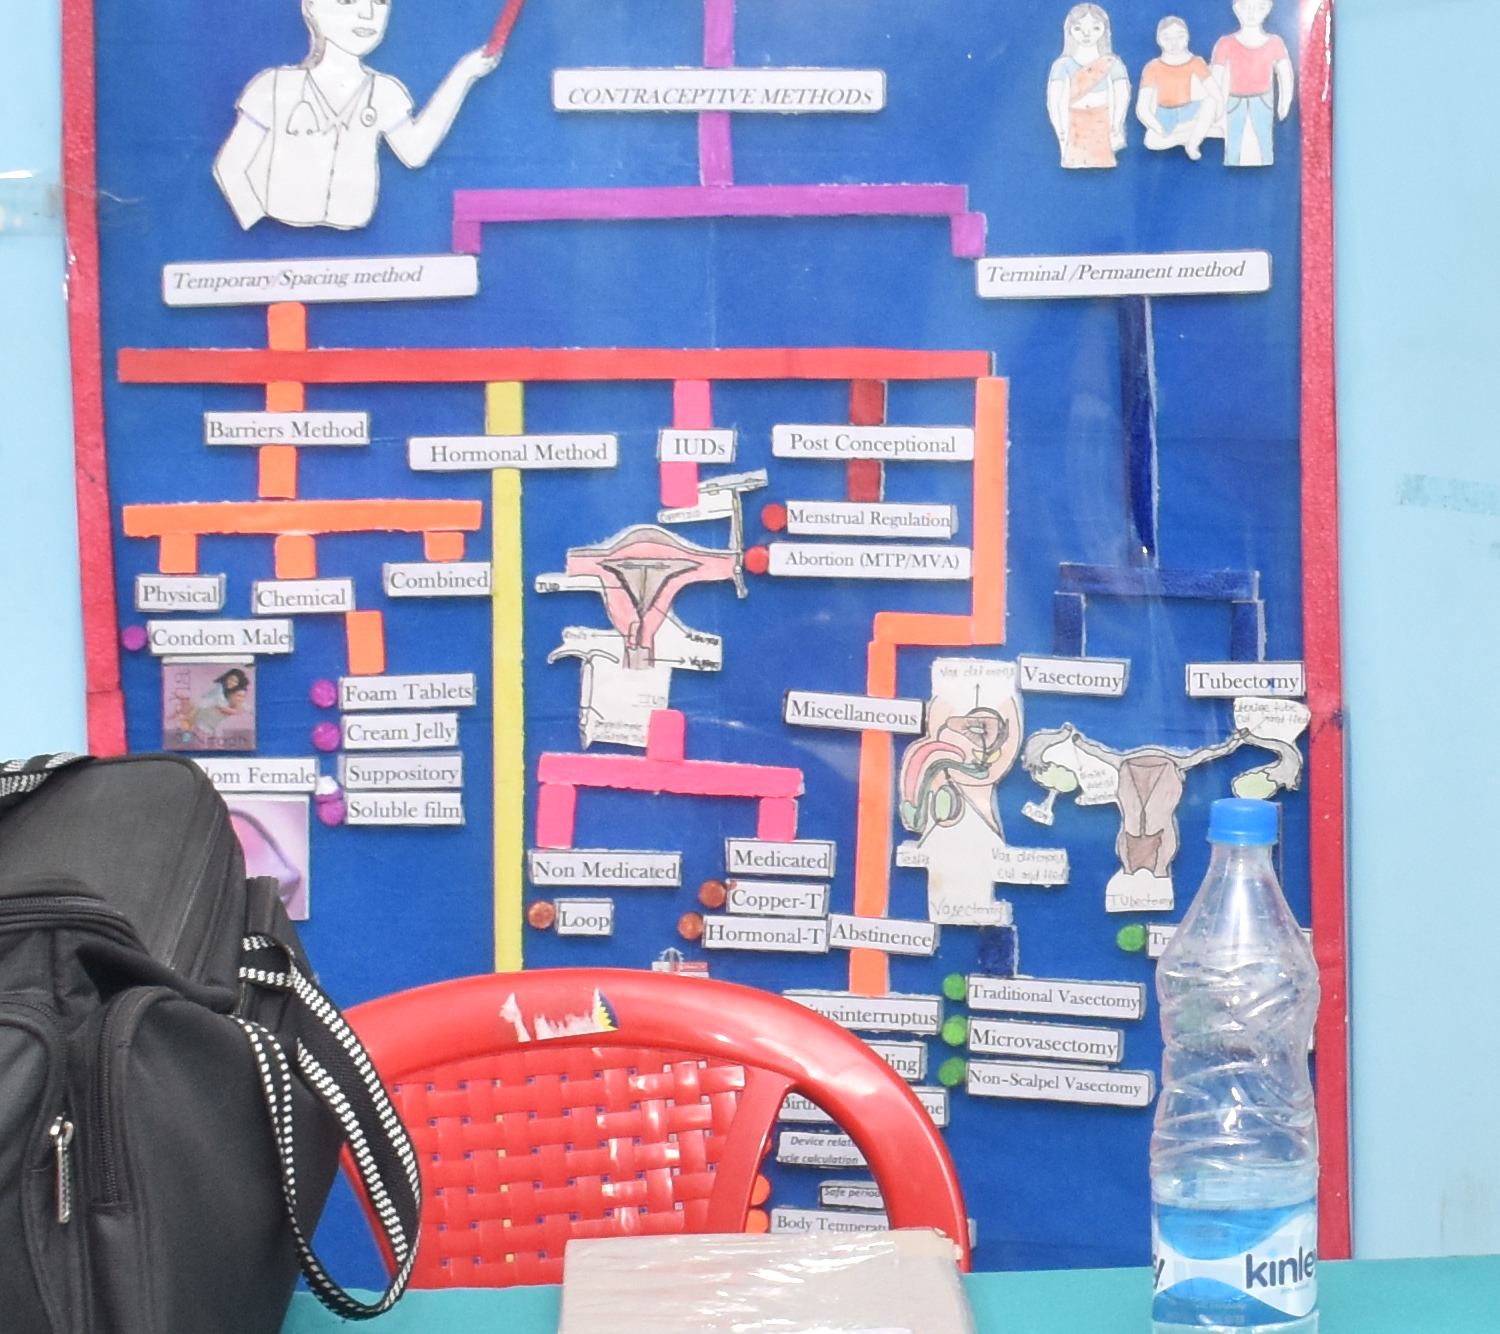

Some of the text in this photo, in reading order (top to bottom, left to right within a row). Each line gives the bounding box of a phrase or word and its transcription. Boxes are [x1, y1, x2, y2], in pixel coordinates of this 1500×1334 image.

[568, 87, 873, 106] CONTRACEPTIVE METHODS
[173, 266, 423, 292] Temporary/Spacing method
[986, 260, 1247, 283] Terminal /Permanent method
[209, 419, 366, 439] Barriers Method
[429, 442, 608, 464] Hormonal Method
[674, 437, 727, 456] IUDs
[790, 433, 956, 456] Post Conceptional
[789, 508, 952, 531] Menstrual Regulation
[785, 551, 960, 570] Abortion (MTP/MVA)
[390, 571, 489, 589] Combined
[143, 584, 221, 607] Physical
[257, 589, 347, 609] Chemical
[152, 627, 290, 646] Condom Male
[1024, 666, 1123, 689] Vasectomy
[1192, 672, 1300, 692] Tubectomy
[345, 682, 473, 703] Foam Tablets
[791, 700, 918, 726] Miscellaneous
[347, 722, 457, 745] Cream Jelly
[248, 765, 317, 784] Female
[349, 764, 460, 785] Suppository
[349, 800, 460, 819] Soluble film
[733, 849, 829, 870] Medicated
[535, 862, 677, 882] Non Medicated
[731, 889, 823, 913] Copper-T
[560, 910, 610, 932] Loop
[707, 924, 824, 946] Hormonal-T
[831, 922, 933, 948] Abstinence
[970, 984, 1140, 1011] Traditional Vasectomy
[810, 1005, 937, 1027] tusinterruptus
[970, 1027, 1118, 1056] Microvasectomy
[968, 1068, 1141, 1098] Non-Scalpel Vasectomy
[790, 1136, 855, 1147] Device relat
[779, 1154, 859, 1165] ycle calculation
[776, 1215, 815, 1231] Body
[1245, 1245, 1315, 1290] kinle
